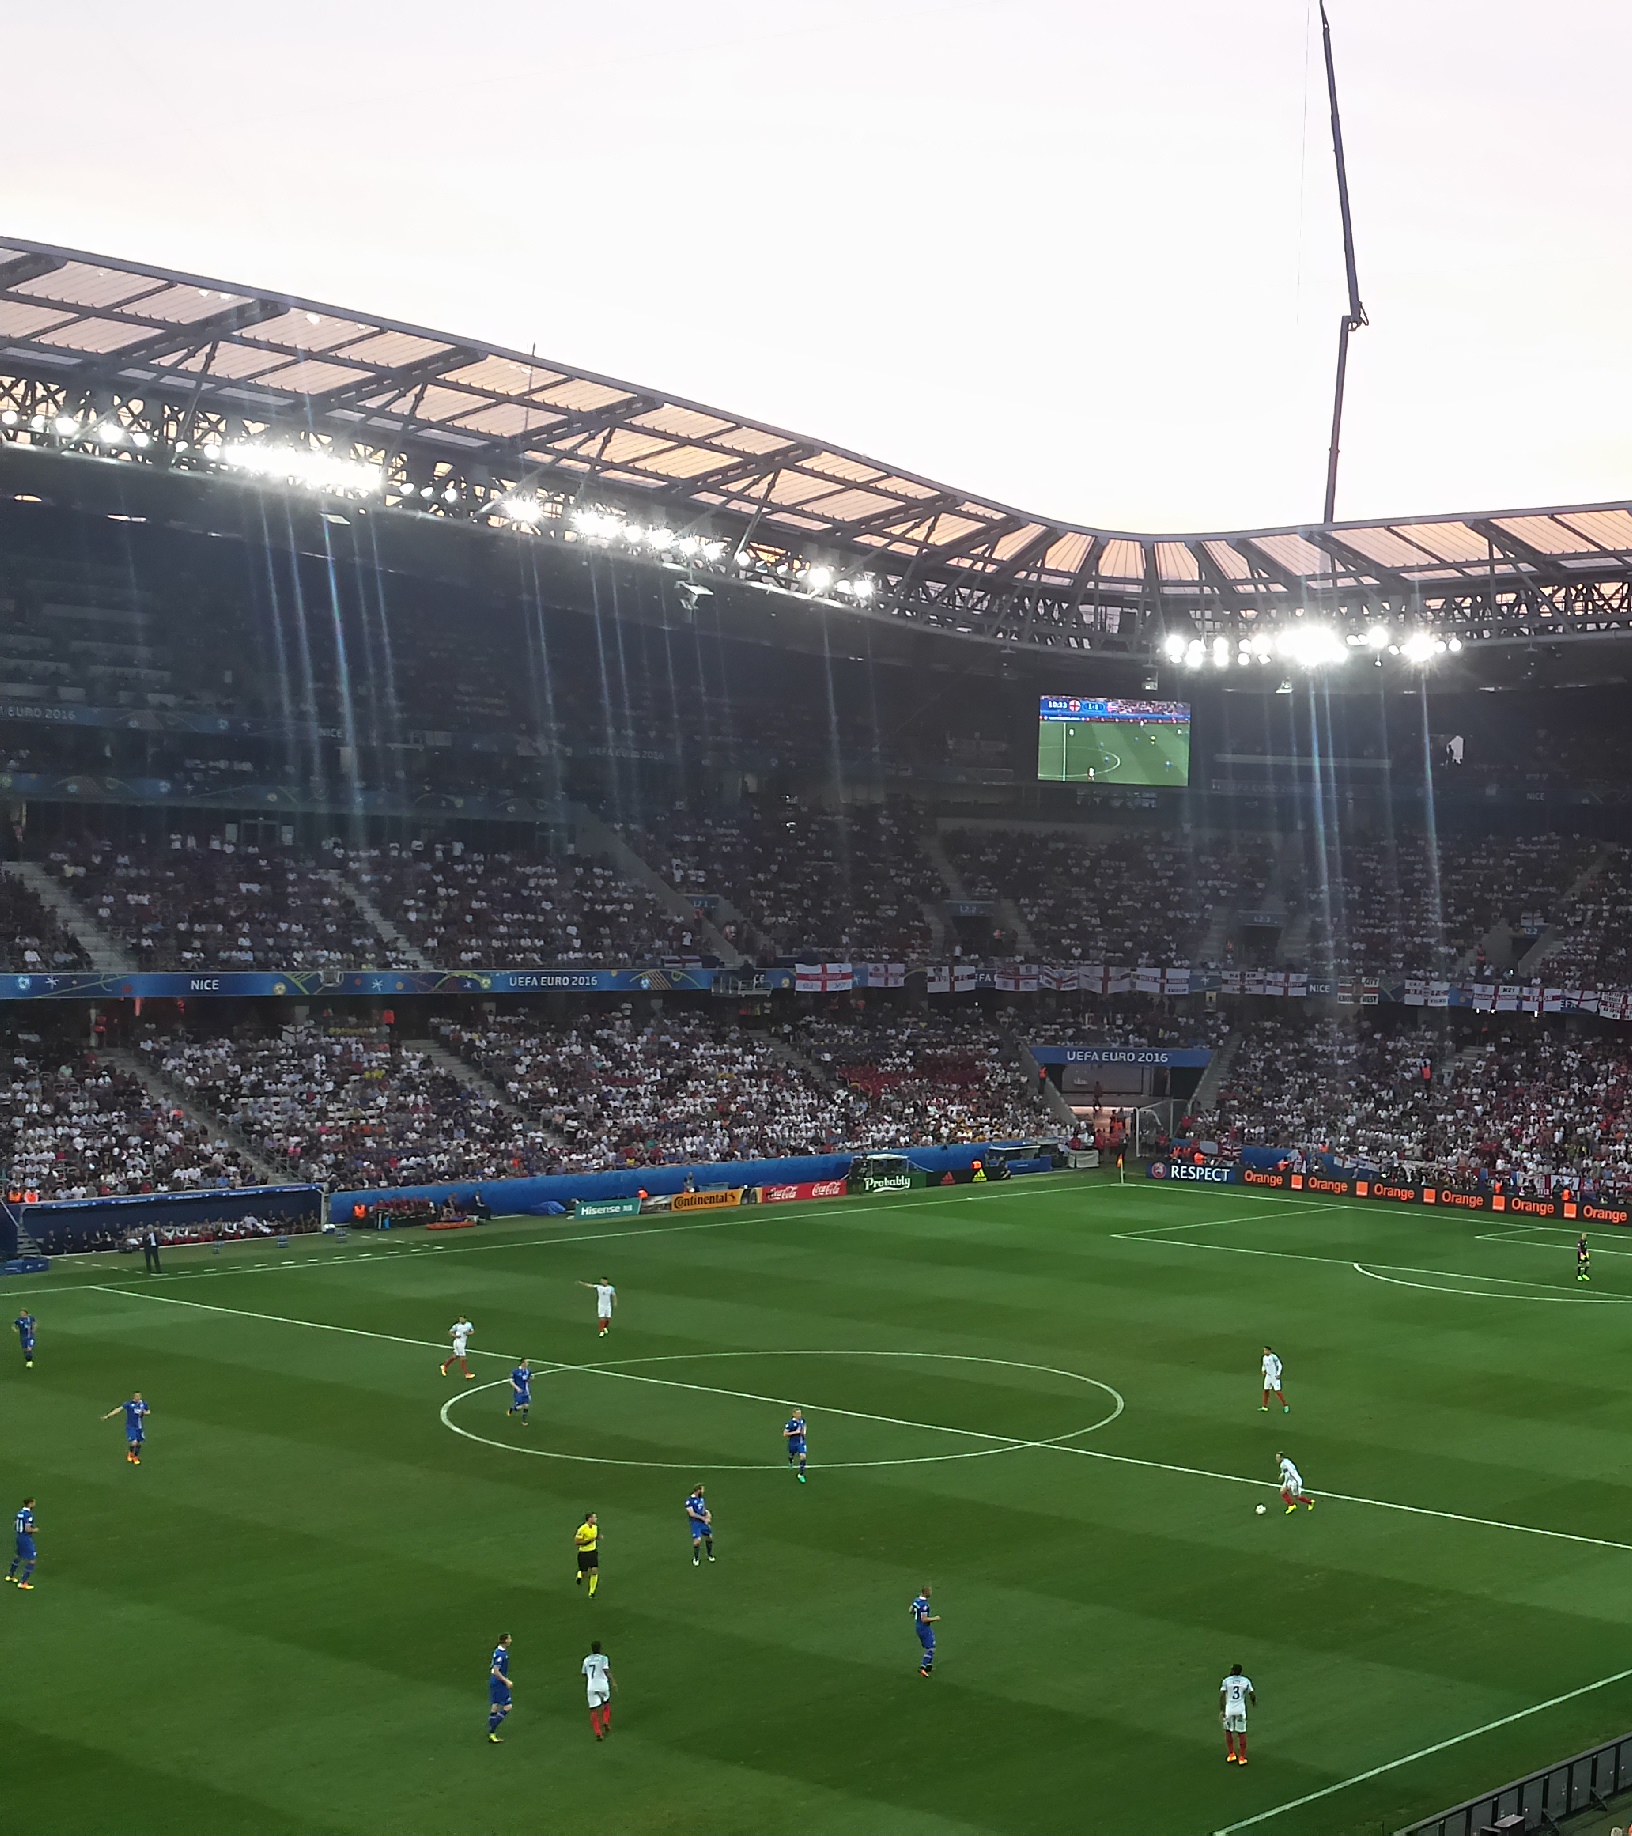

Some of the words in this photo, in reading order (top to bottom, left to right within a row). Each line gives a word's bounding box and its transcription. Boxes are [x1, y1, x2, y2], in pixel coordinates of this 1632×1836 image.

[1526, 791, 1545, 801] NICE
[190, 979, 220, 991] NICE
[509, 976, 538, 988] UEFA
[540, 976, 570, 987] EURO
[571, 976, 598, 987] 2016
[1309, 984, 1330, 993] NICE
[1067, 1050, 1100, 1062] UEFA
[1101, 1051, 1136, 1062] EURO
[1137, 1052, 1169, 1063] 2016
[1170, 1165, 1231, 1182] RESPECT
[1244, 1169, 1284, 1188] Orange
[864, 1175, 911, 1191] Probably
[1308, 1176, 1349, 1195] Orange
[1373, 1182, 1416, 1202] Orange
[1441, 1189, 1484, 1210] Orange
[674, 1193, 729, 1209] Continental
[1511, 1196, 1555, 1217] Orange
[581, 1205, 622, 1216] Hisense
[1583, 1203, 1628, 1225] Orange
[588, 1664, 597, 1680] 7
[1232, 1685, 1241, 1700] 3
